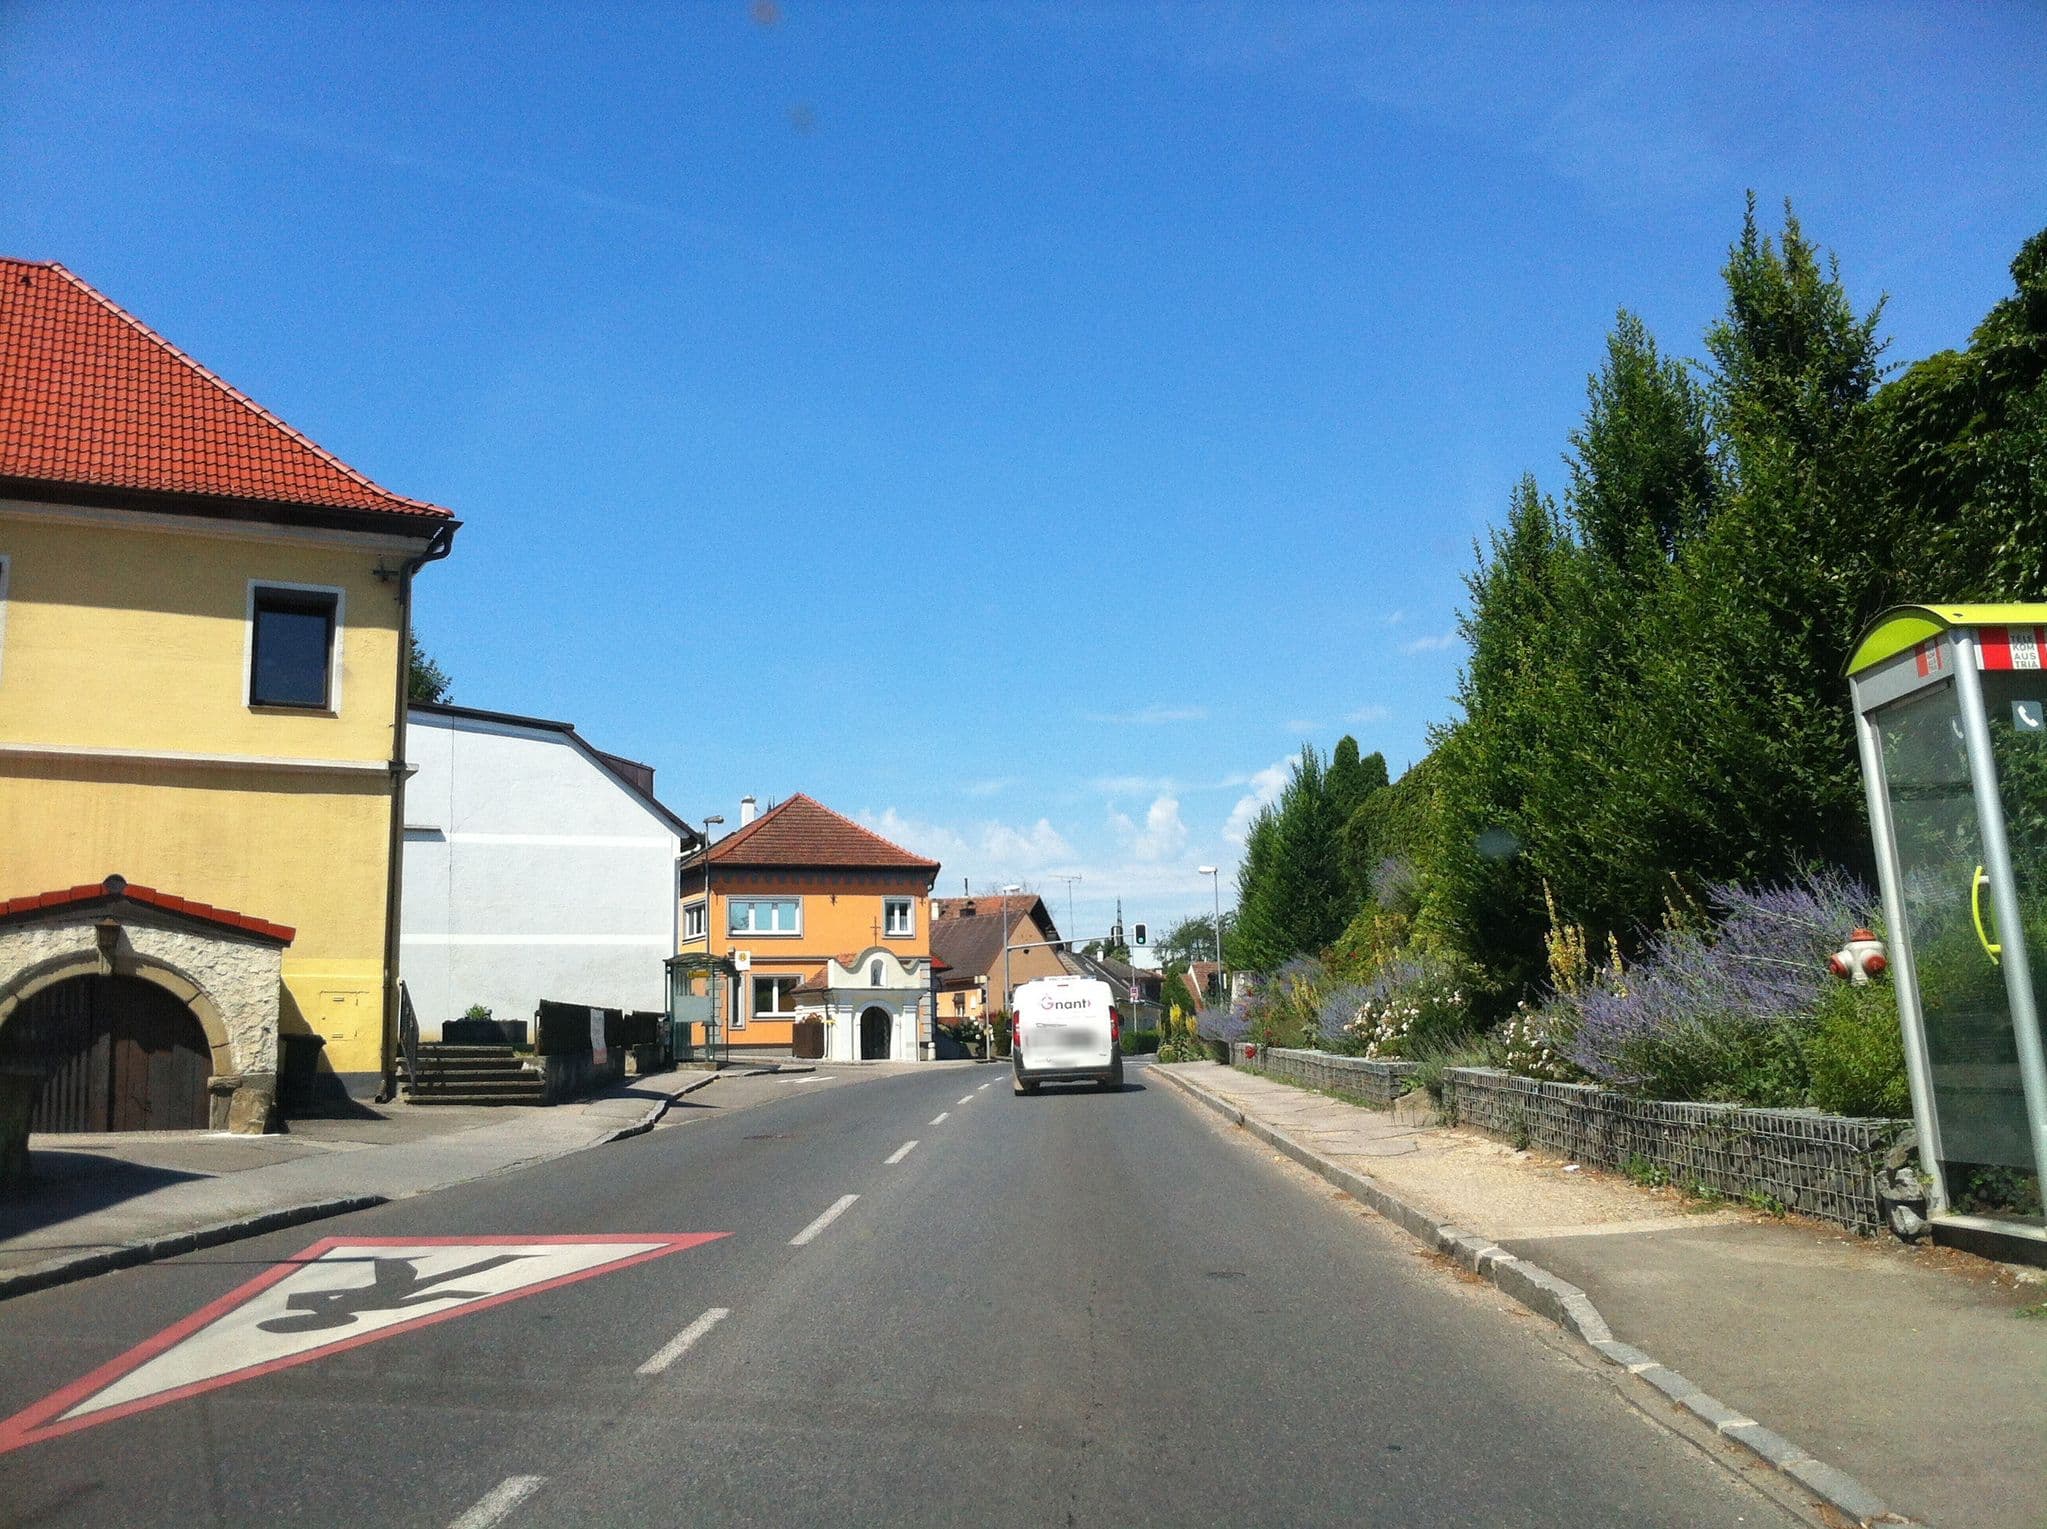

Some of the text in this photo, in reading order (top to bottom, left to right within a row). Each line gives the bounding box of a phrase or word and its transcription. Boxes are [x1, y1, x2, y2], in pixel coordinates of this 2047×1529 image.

[2010, 634, 2033, 643] TELE
[2013, 643, 2035, 651] KOM
[2014, 652, 2037, 660] AUS
[2015, 660, 2039, 668] TRIA
